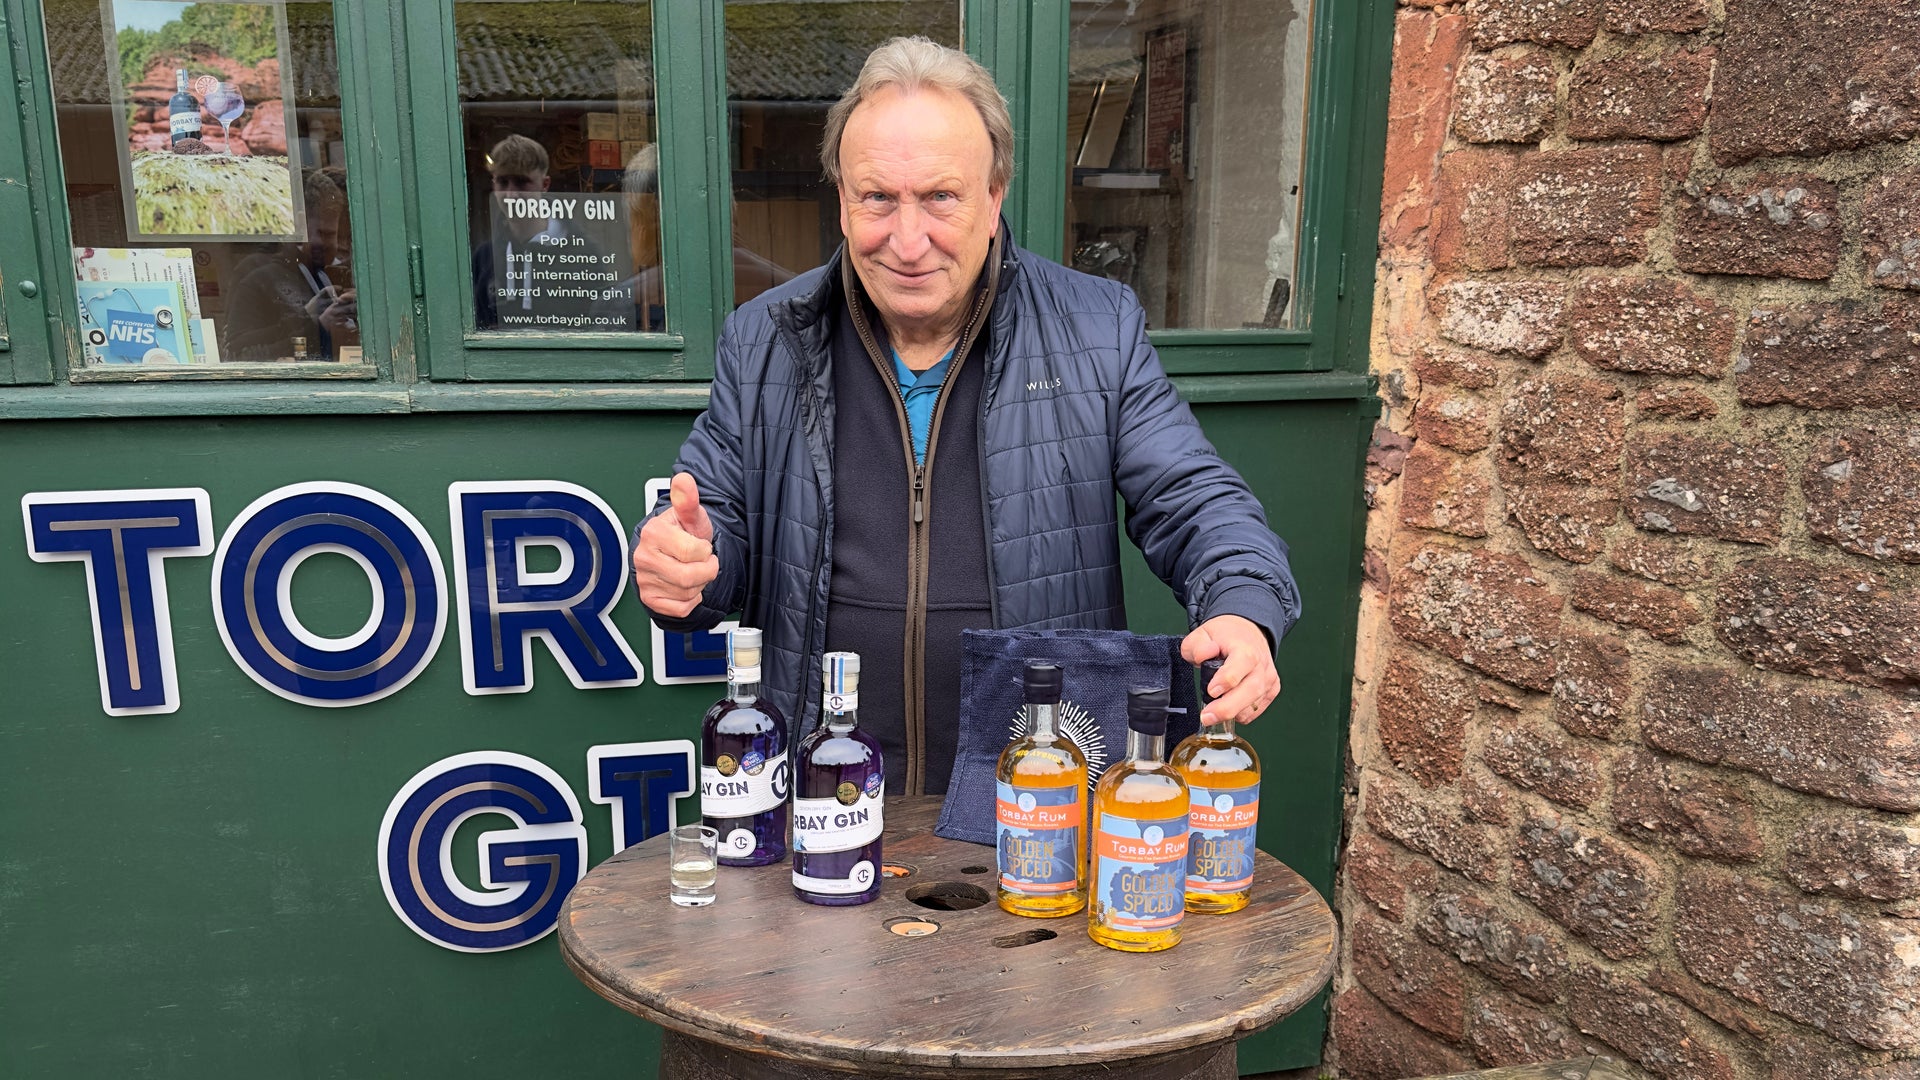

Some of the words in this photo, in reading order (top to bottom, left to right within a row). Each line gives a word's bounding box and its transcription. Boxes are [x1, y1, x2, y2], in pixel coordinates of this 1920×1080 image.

[503, 198, 577, 219] TORBAY
[584, 200, 615, 220] GIN
[540, 235, 568, 248] Pop
[572, 235, 585, 246] in
[507, 252, 533, 262] and
[537, 253, 555, 265] try
[560, 255, 598, 263] some
[602, 253, 616, 264] of
[506, 271, 528, 280] our
[533, 269, 618, 281] international
[498, 286, 540, 297] award
[547, 286, 598, 300] winning
[602, 287, 623, 300] gin
[503, 314, 627, 326] www.torbaygin.co.uk
[109, 324, 155, 344] NHS
[1026, 377, 1061, 391] WILLS
[716, 781, 749, 796] GIN
[834, 808, 869, 828] GIN
[998, 804, 1035, 822] TORBAY
[1038, 811, 1067, 823] RUM
[1234, 811, 1255, 821] RUM
[1005, 836, 1055, 859] GOLDEN
[1112, 841, 1162, 856] TORBAY
[1165, 842, 1186, 854] RUM
[1194, 838, 1246, 859] GOLDEN
[1007, 855, 1053, 878] SPICED
[1195, 858, 1243, 877] SPICED
[1121, 872, 1177, 893] GOLDEN
[1123, 893, 1174, 914] SPICED
